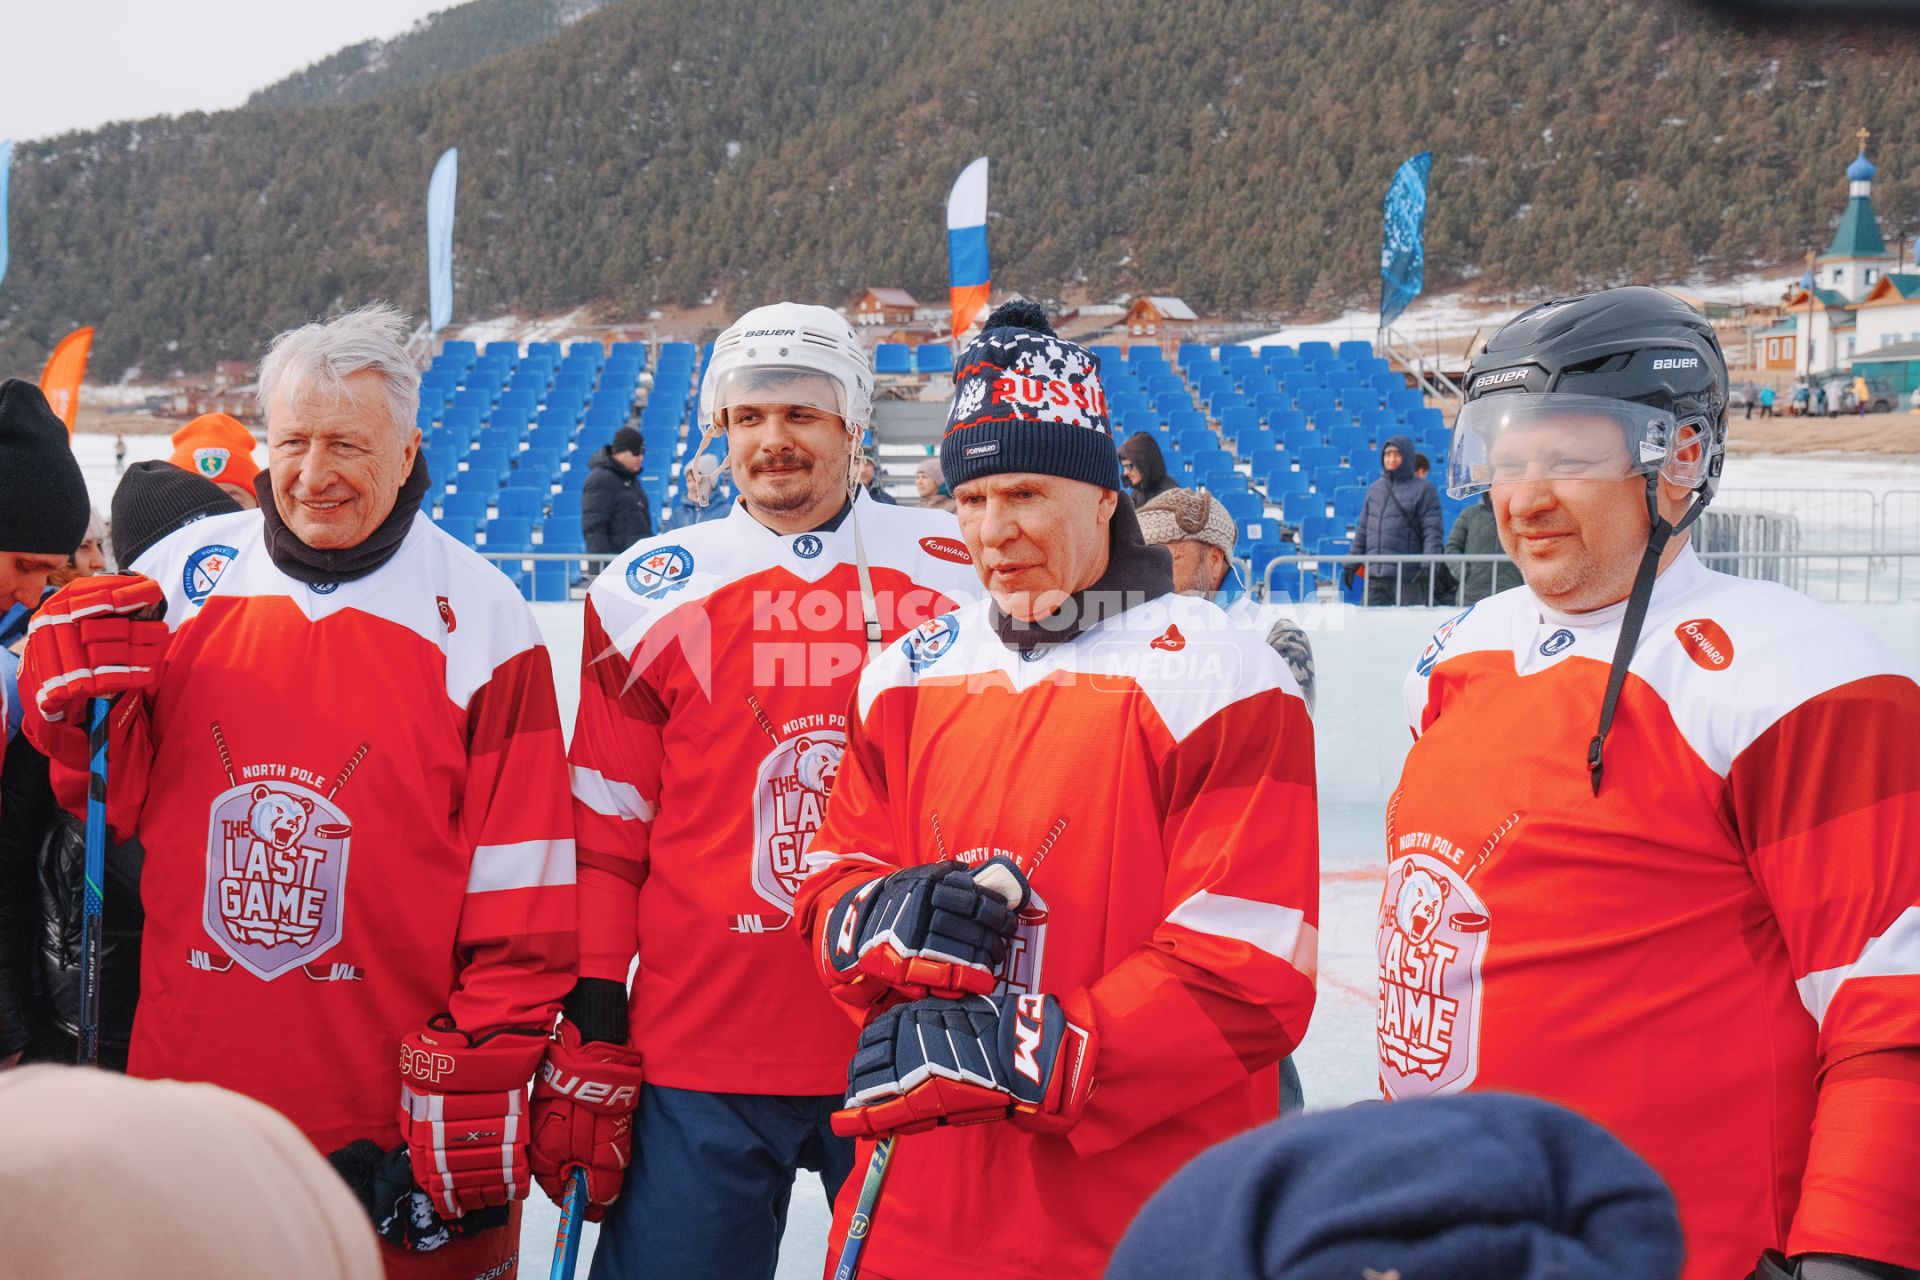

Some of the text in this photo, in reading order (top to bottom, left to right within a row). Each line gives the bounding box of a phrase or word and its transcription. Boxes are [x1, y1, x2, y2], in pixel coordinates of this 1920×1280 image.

[1653, 358, 1698, 370] BAUER
[1475, 369, 1529, 388] BAUER
[925, 539, 971, 561] FORWARD
[1681, 621, 1726, 665] FORWARD
[783, 713, 846, 736] NORTH PO
[242, 763, 327, 788] NORTH POLE
[774, 789, 826, 834] LA
[221, 820, 251, 840] THE
[1399, 831, 1465, 865] NORTH POLE
[223, 838, 326, 891] LAST
[219, 878, 327, 928] GAME
